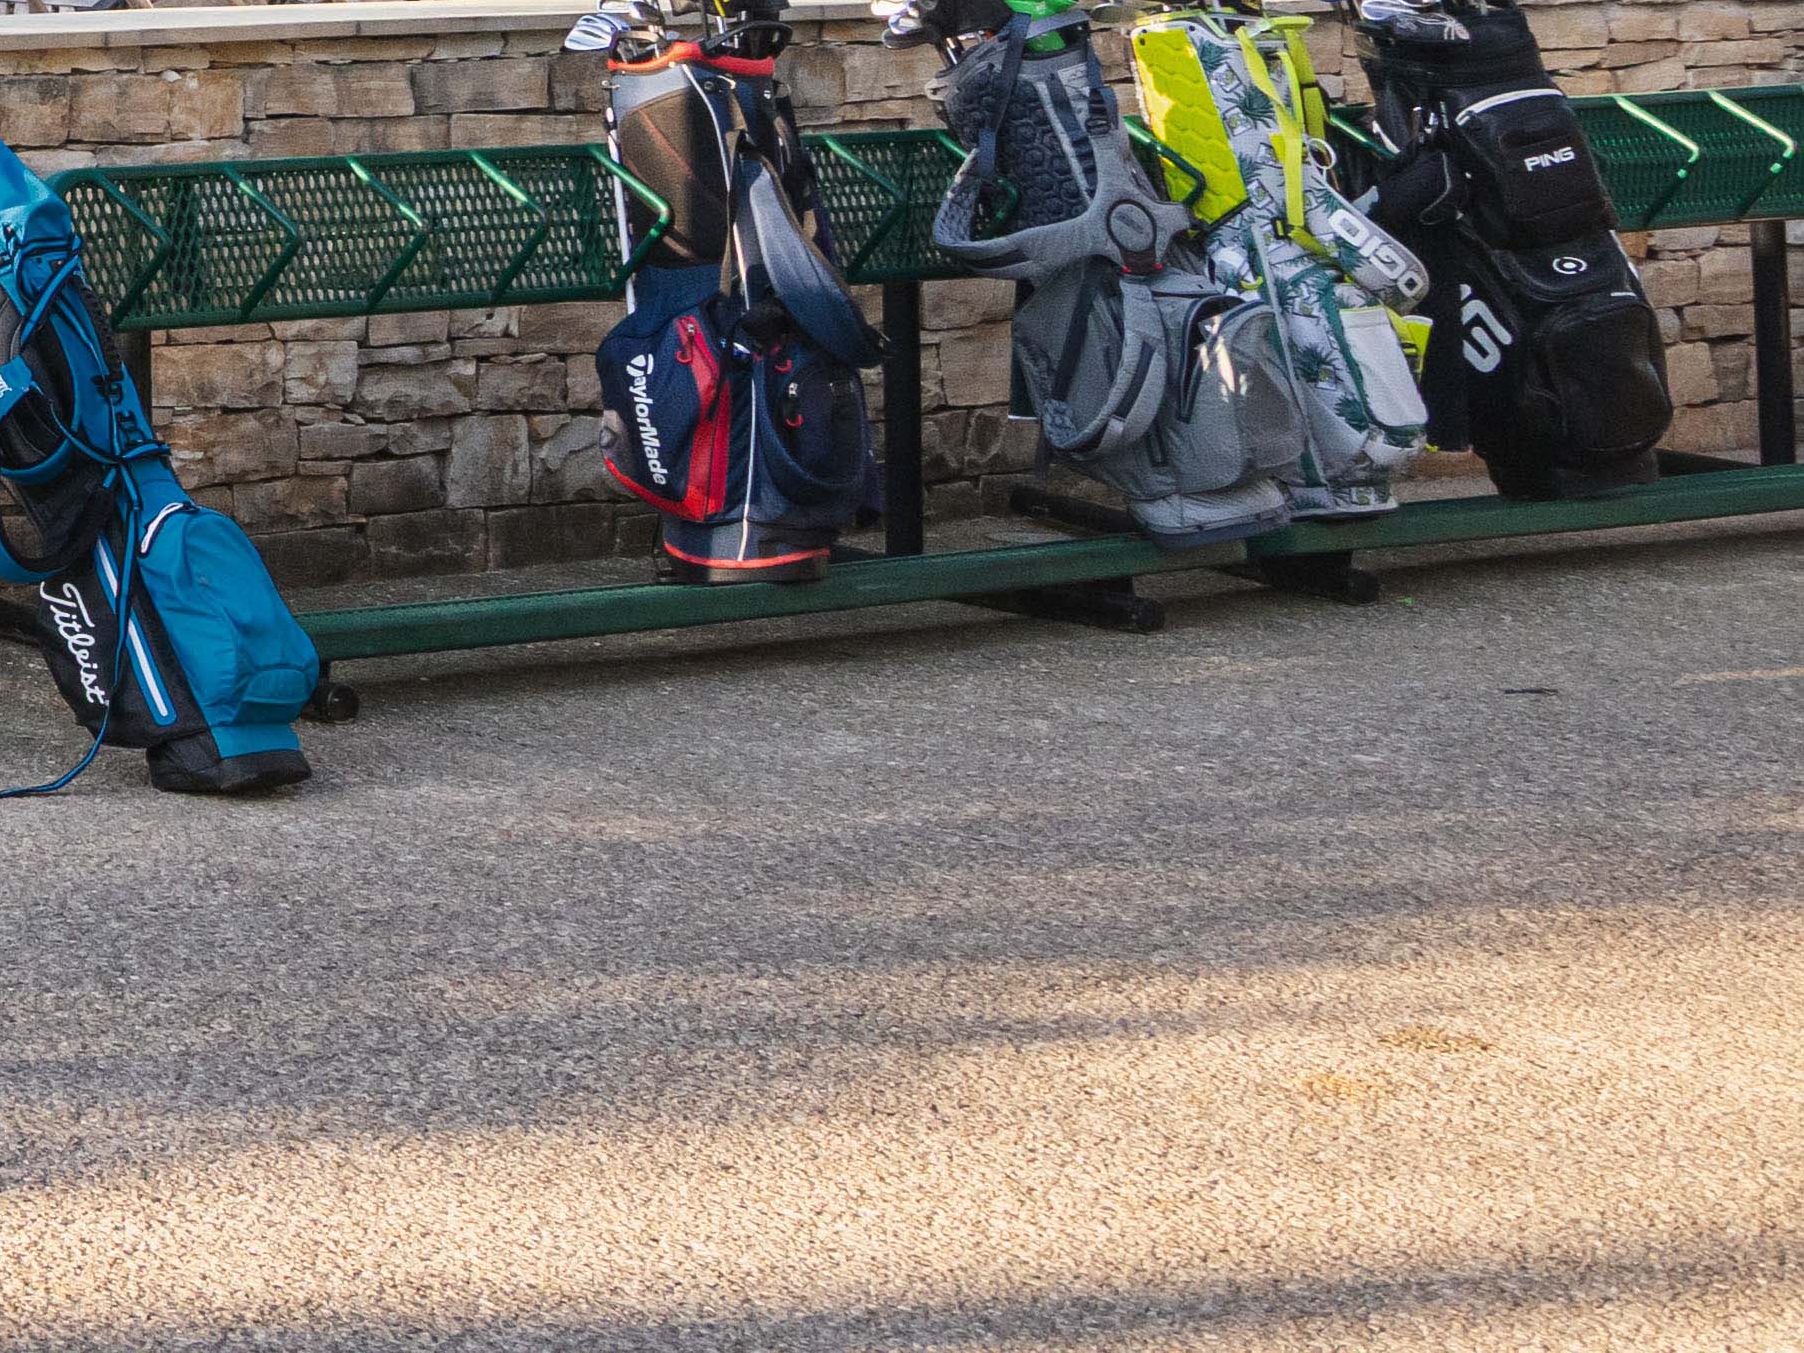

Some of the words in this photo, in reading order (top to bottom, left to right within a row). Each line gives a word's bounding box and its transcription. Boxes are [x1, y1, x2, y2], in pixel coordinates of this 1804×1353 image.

[1524, 146, 1576, 172] PING
[1328, 209, 1424, 298] OGIO
[626, 353, 669, 485] TaylorMade
[39, 580, 109, 707] Titleist
